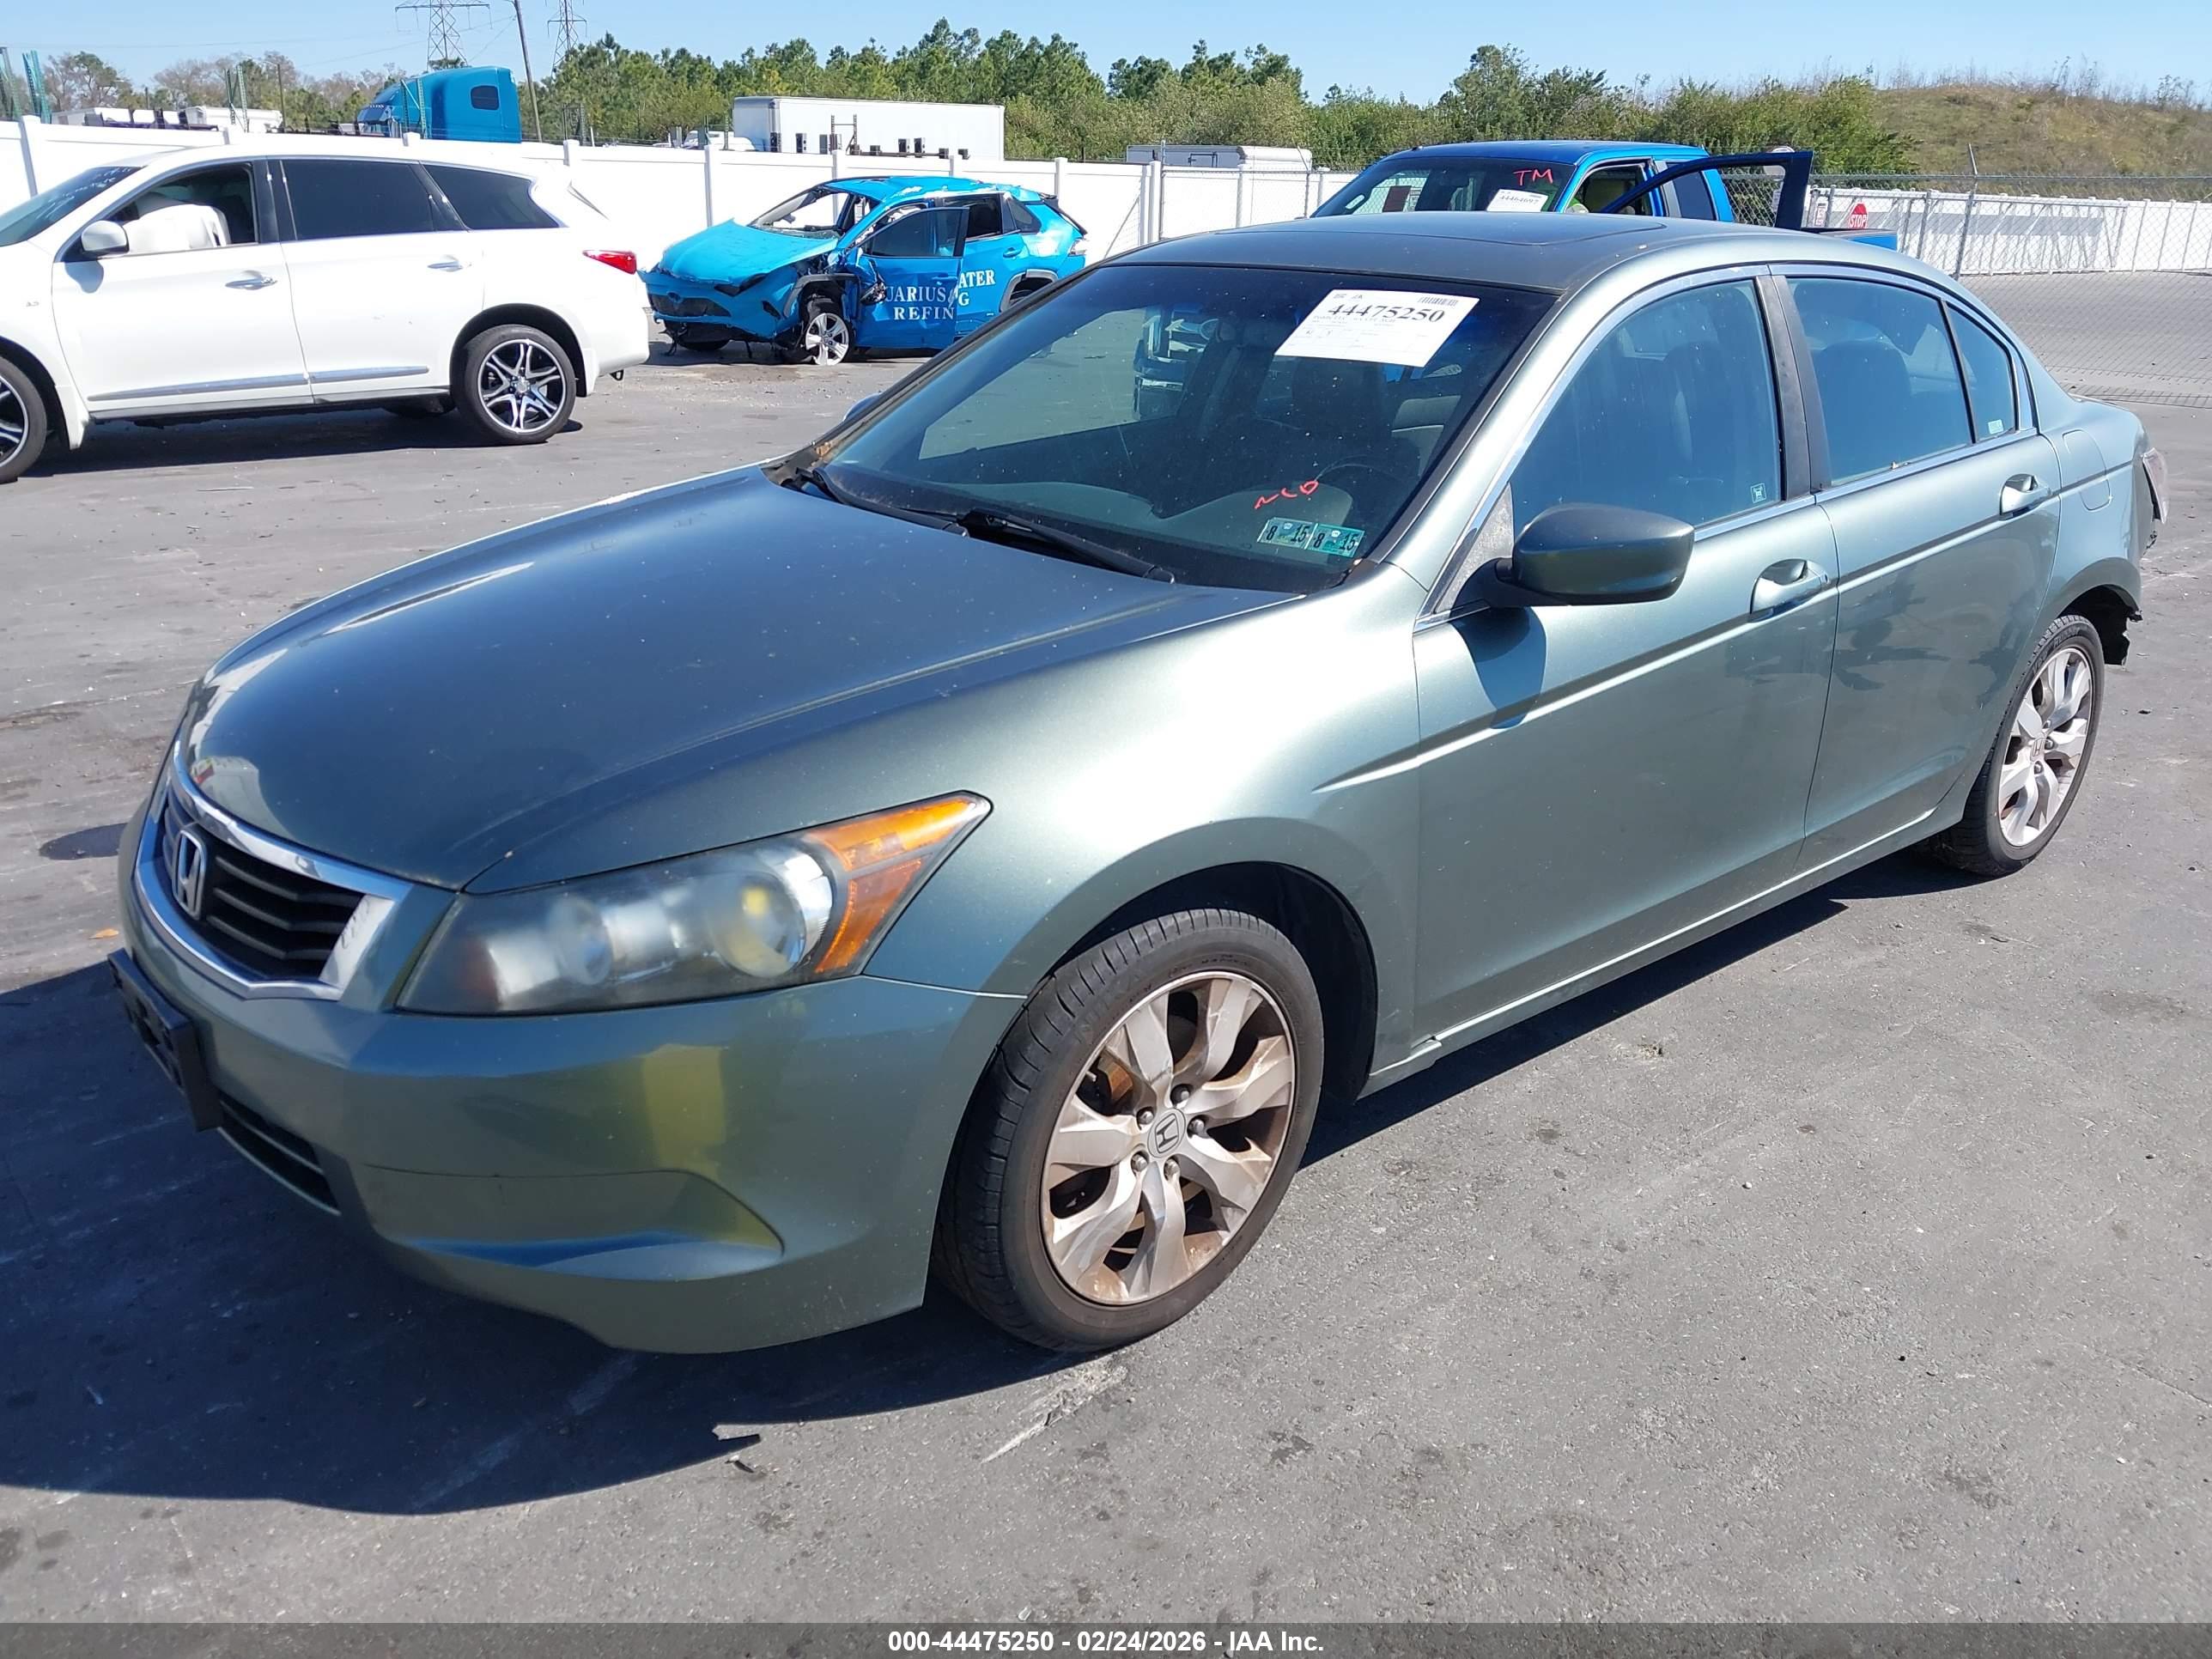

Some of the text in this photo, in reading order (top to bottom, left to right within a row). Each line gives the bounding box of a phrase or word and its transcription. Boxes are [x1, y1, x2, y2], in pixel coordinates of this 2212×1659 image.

[1513, 169, 1553, 185] TM
[1850, 214, 1867, 228] STOP
[1328, 303, 1446, 323] 44475250
[1266, 524, 1310, 543] 8 15
[1313, 532, 1359, 551] 8 15
